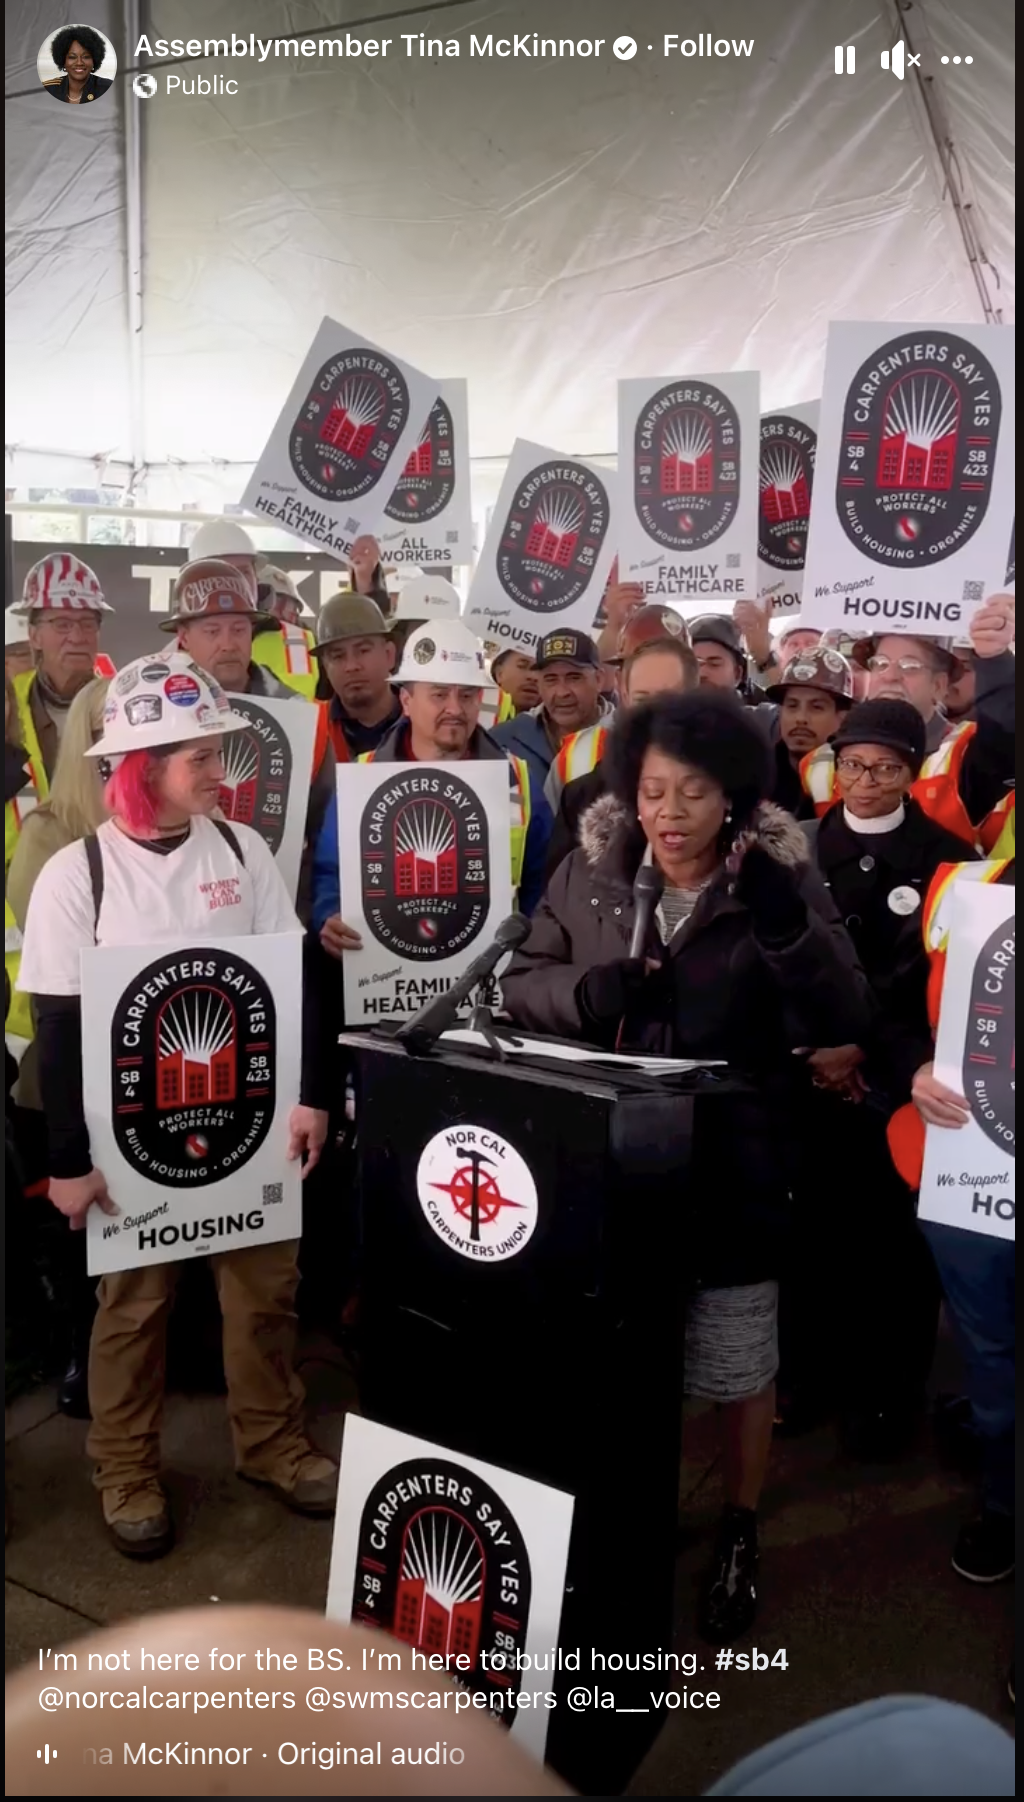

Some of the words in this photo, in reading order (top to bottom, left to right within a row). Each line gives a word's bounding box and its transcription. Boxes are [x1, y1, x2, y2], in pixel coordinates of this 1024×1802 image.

[320, 357, 389, 392] CARPENTERS
[387, 377, 403, 402] SAY
[854, 344, 949, 422] CARPENTERS
[951, 353, 985, 386] SAY
[973, 390, 991, 427] YES
[387, 407, 403, 431] YES
[436, 414, 449, 437] YES
[640, 389, 702, 450] CARPENTERS
[703, 394, 727, 418] SAY
[720, 418, 735, 445] YES
[787, 426, 810, 445] SAY
[847, 446, 865, 458] SB
[968, 451, 987, 463] SB
[722, 461, 735, 471] SB
[849, 460, 859, 472] 4
[962, 464, 988, 477] 423
[519, 468, 585, 509] CARPENTERS
[583, 481, 602, 508] SAY
[875, 493, 926, 506] PROTECT
[929, 497, 948, 510] ALL
[882, 502, 937, 515] WORKERS
[283, 496, 339, 531] FAMILY
[589, 510, 604, 535] YES
[254, 495, 353, 556] HEALTHCARE
[510, 521, 522, 532] SB
[845, 500, 863, 535] BUILD
[863, 535, 915, 560] HOUSING
[929, 505, 977, 555] ORGANIZE
[401, 537, 429, 550] ALL
[582, 546, 594, 557] SB
[379, 549, 452, 563] WORKERS
[658, 564, 719, 581] FAMILY
[814, 585, 831, 599] We
[831, 575, 876, 598] Support
[843, 597, 962, 622] HOUSING
[487, 619, 543, 648] HOUSI
[252, 718, 279, 744] SAY
[270, 748, 284, 776] YES
[266, 793, 281, 804] SB
[262, 804, 283, 815] 423
[369, 779, 440, 845] CARPENTERS
[444, 785, 472, 809] SAY
[464, 811, 481, 842] YES
[367, 863, 382, 874] SB
[468, 860, 483, 870] SB
[199, 876, 240, 894] WOMEN
[371, 874, 379, 885] 4
[465, 871, 486, 881] 423
[209, 894, 242, 910] BUILD
[211, 888, 236, 899] CAN
[397, 898, 439, 912] PROTECT
[442, 899, 458, 911] ALL
[404, 907, 449, 917] WORKERS
[371, 908, 391, 938] BUILD
[391, 936, 437, 954] HOUSING
[448, 905, 482, 948] ORGANIZE
[123, 961, 217, 1047] CARPENTERS
[221, 966, 256, 996] SAY
[247, 997, 266, 1034] YES
[976, 1017, 997, 1034] SB
[979, 1033, 990, 1048] 4
[249, 1056, 267, 1068] SB
[120, 1071, 140, 1084] SB
[246, 1069, 271, 1083] 423
[125, 1085, 135, 1098] 4
[974, 1080, 996, 1120] BUILD
[158, 1108, 211, 1128] PROTECT
[215, 1108, 234, 1120] ALL
[167, 1118, 225, 1134] WORKERS
[125, 1127, 149, 1162] BUILD
[149, 1160, 208, 1178] HOUSING
[222, 1110, 265, 1166] ORGANIZE
[445, 1131, 476, 1147] NOR
[480, 1135, 507, 1159] CAL
[937, 1173, 956, 1187] We
[957, 1170, 1010, 1189] Support
[102, 1223, 120, 1240] We
[122, 1202, 170, 1232] Support
[427, 1200, 495, 1257] CARPENTERS
[496, 1221, 528, 1255] UNION
[138, 1210, 265, 1251] HOUSING
[370, 1474, 473, 1550] CARPENTERS
[476, 1502, 512, 1547] SAY
[500, 1559, 520, 1606] YES
[363, 1575, 382, 1594] SB
[365, 1594, 376, 1609] 4
[494, 1631, 516, 1651] SB
